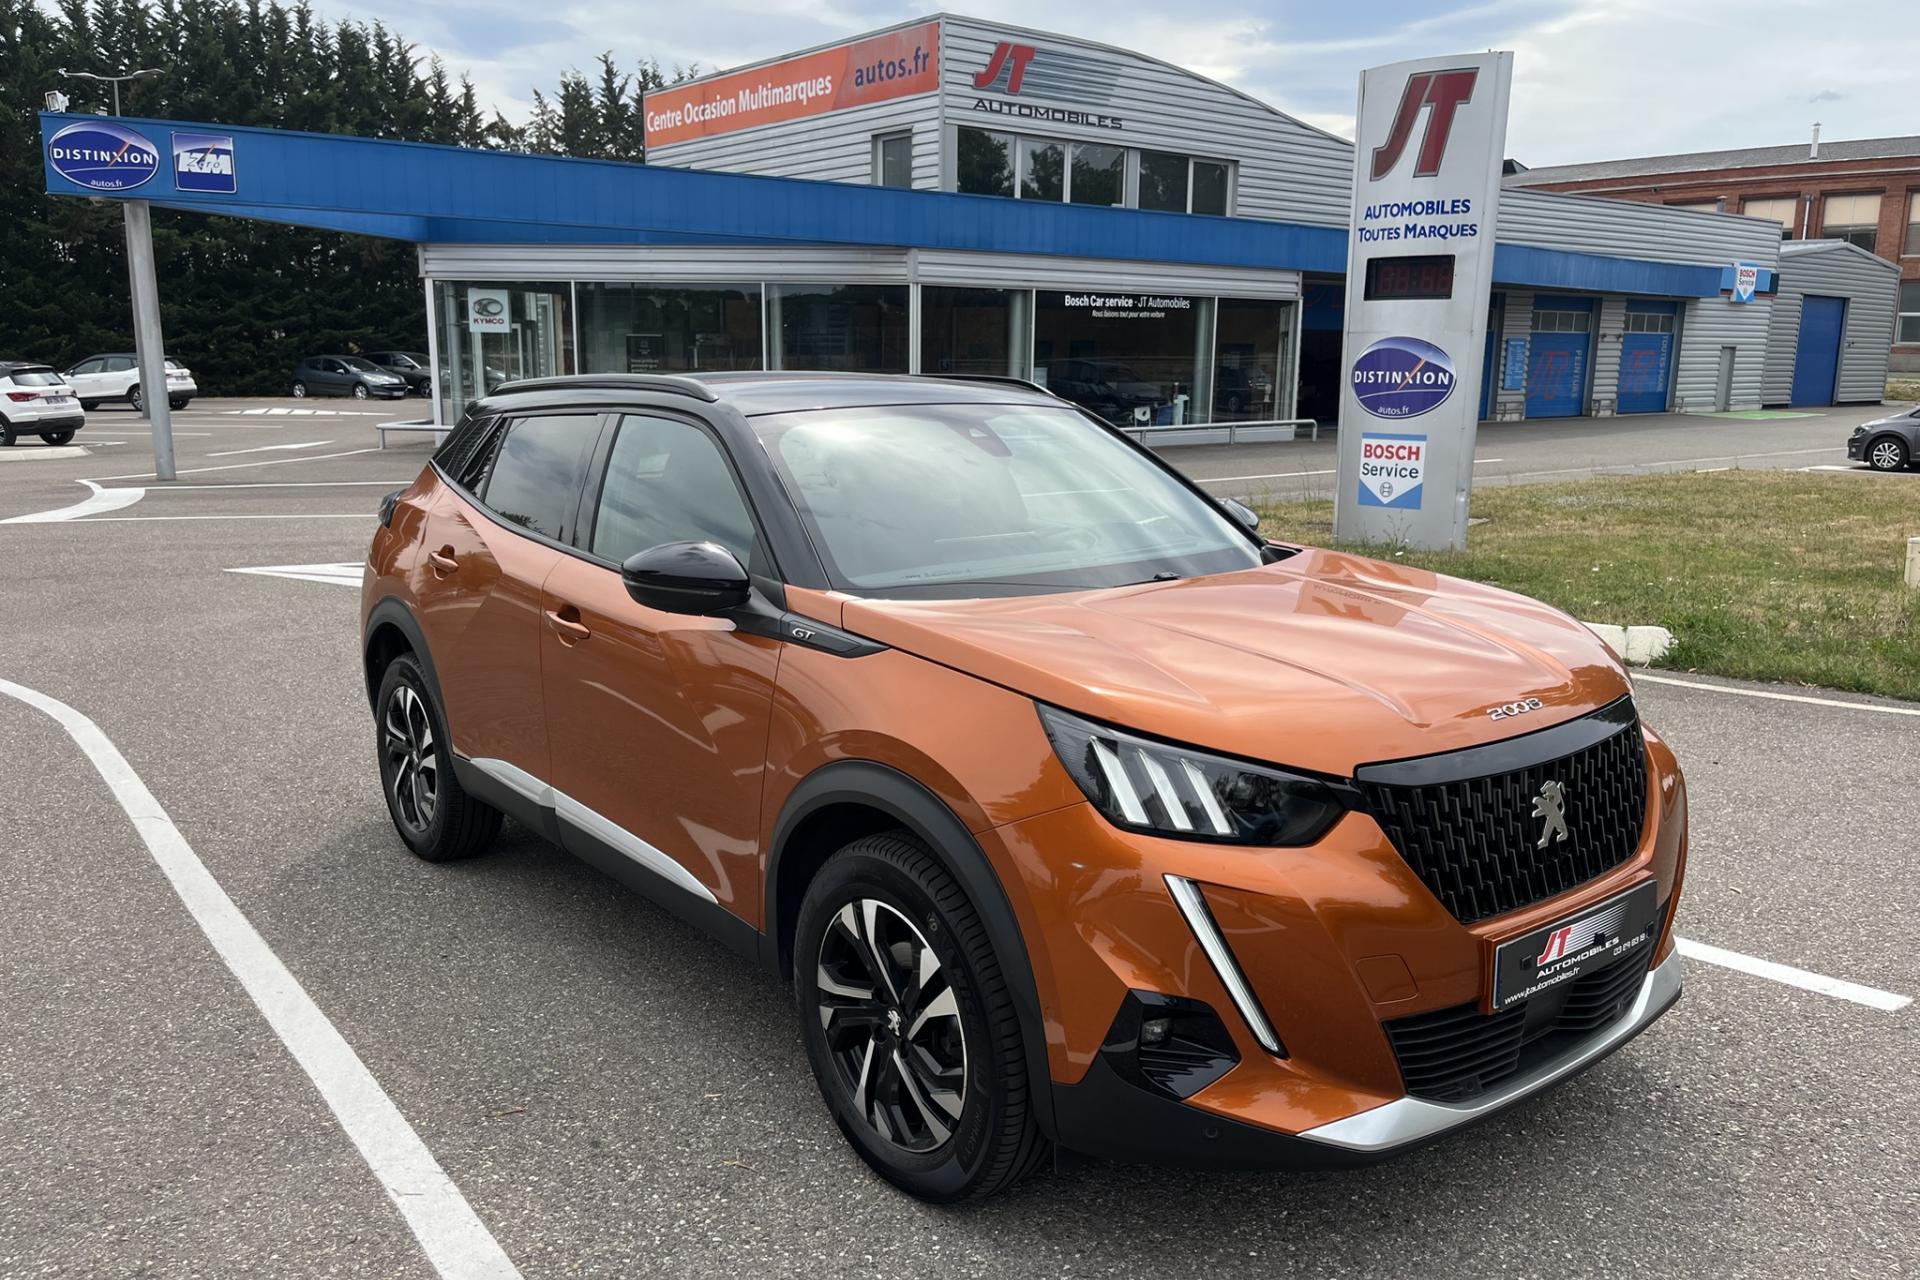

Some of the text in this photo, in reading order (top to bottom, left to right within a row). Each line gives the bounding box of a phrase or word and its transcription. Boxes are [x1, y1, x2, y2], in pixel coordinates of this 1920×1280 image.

[973, 41, 1036, 95] JT
[646, 46, 930, 132] Centre Occasion Multimarques autos.fr
[973, 99, 1123, 129] AUTOMOBILES
[1369, 67, 1480, 182] JT
[53, 147, 154, 165] DISTINXION
[90, 178, 123, 188] autos.fr
[1364, 199, 1471, 220] AUTOMOBILES
[1358, 221, 1478, 243] TOUTES MARQUES
[1064, 294, 1089, 307] Bosch
[1090, 295, 1104, 307] Car
[1105, 295, 1133, 307] service
[1138, 296, 1147, 307] JT
[1147, 296, 1190, 309] Automobiles
[473, 317, 504, 325] KYMCO
[1354, 369, 1450, 386] DISTINXION
[1377, 405, 1410, 416] autos.fr
[1363, 443, 1421, 461] BOSCH
[1362, 462, 1419, 479] Service
[791, 627, 816, 640] GT
[1486, 697, 1543, 721] 2008
[1537, 926, 1573, 967] JT
[1536, 936, 1619, 979] AUTOMOBILES
